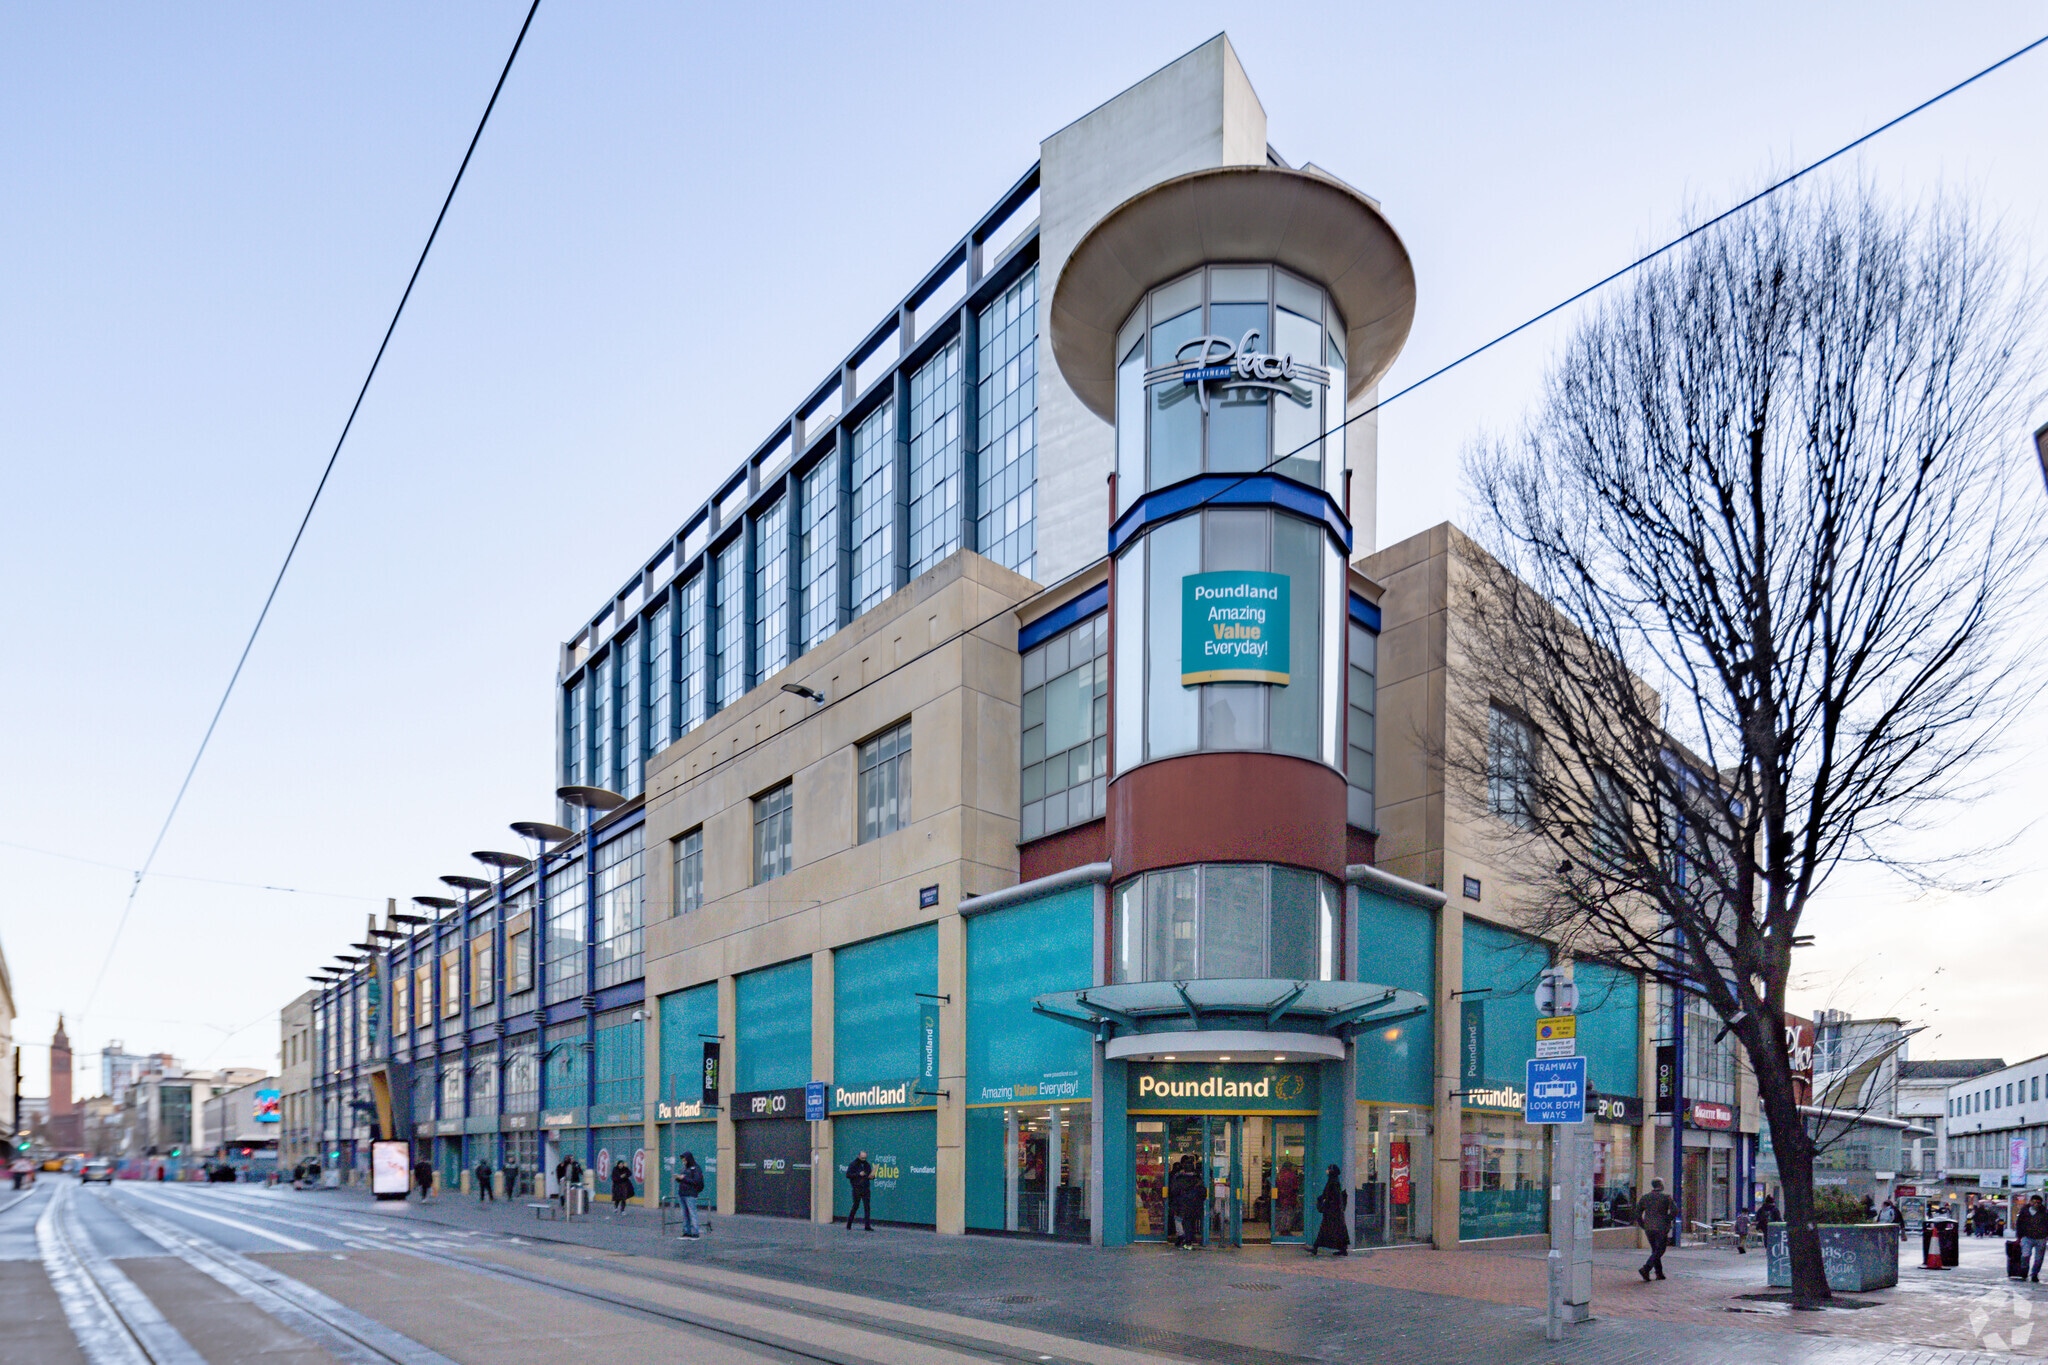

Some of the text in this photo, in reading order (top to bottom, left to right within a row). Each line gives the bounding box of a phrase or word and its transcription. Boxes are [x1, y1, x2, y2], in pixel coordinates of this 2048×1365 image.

[1175, 328, 1297, 414] Place
[1185, 367, 1230, 380] MARTINEAU
[1195, 584, 1278, 600] Poundland
[1208, 605, 1266, 624] Amazing
[1213, 622, 1261, 640] Value
[1204, 640, 1268, 658] Everyday!
[925, 1028, 933, 1077] Poundland
[1468, 1026, 1477, 1077] Poundland
[1534, 1062, 1578, 1071] TRAMWAY
[836, 1083, 905, 1107] Poundland
[982, 1080, 1079, 1099] Amazing Value Everyday!
[1139, 1075, 1268, 1097] Poundland
[1468, 1086, 1525, 1108] Poundla
[1530, 1100, 1580, 1110] LOOK BOTH
[1542, 1111, 1567, 1119] WAYS
[910, 1166, 935, 1174] Poundland
